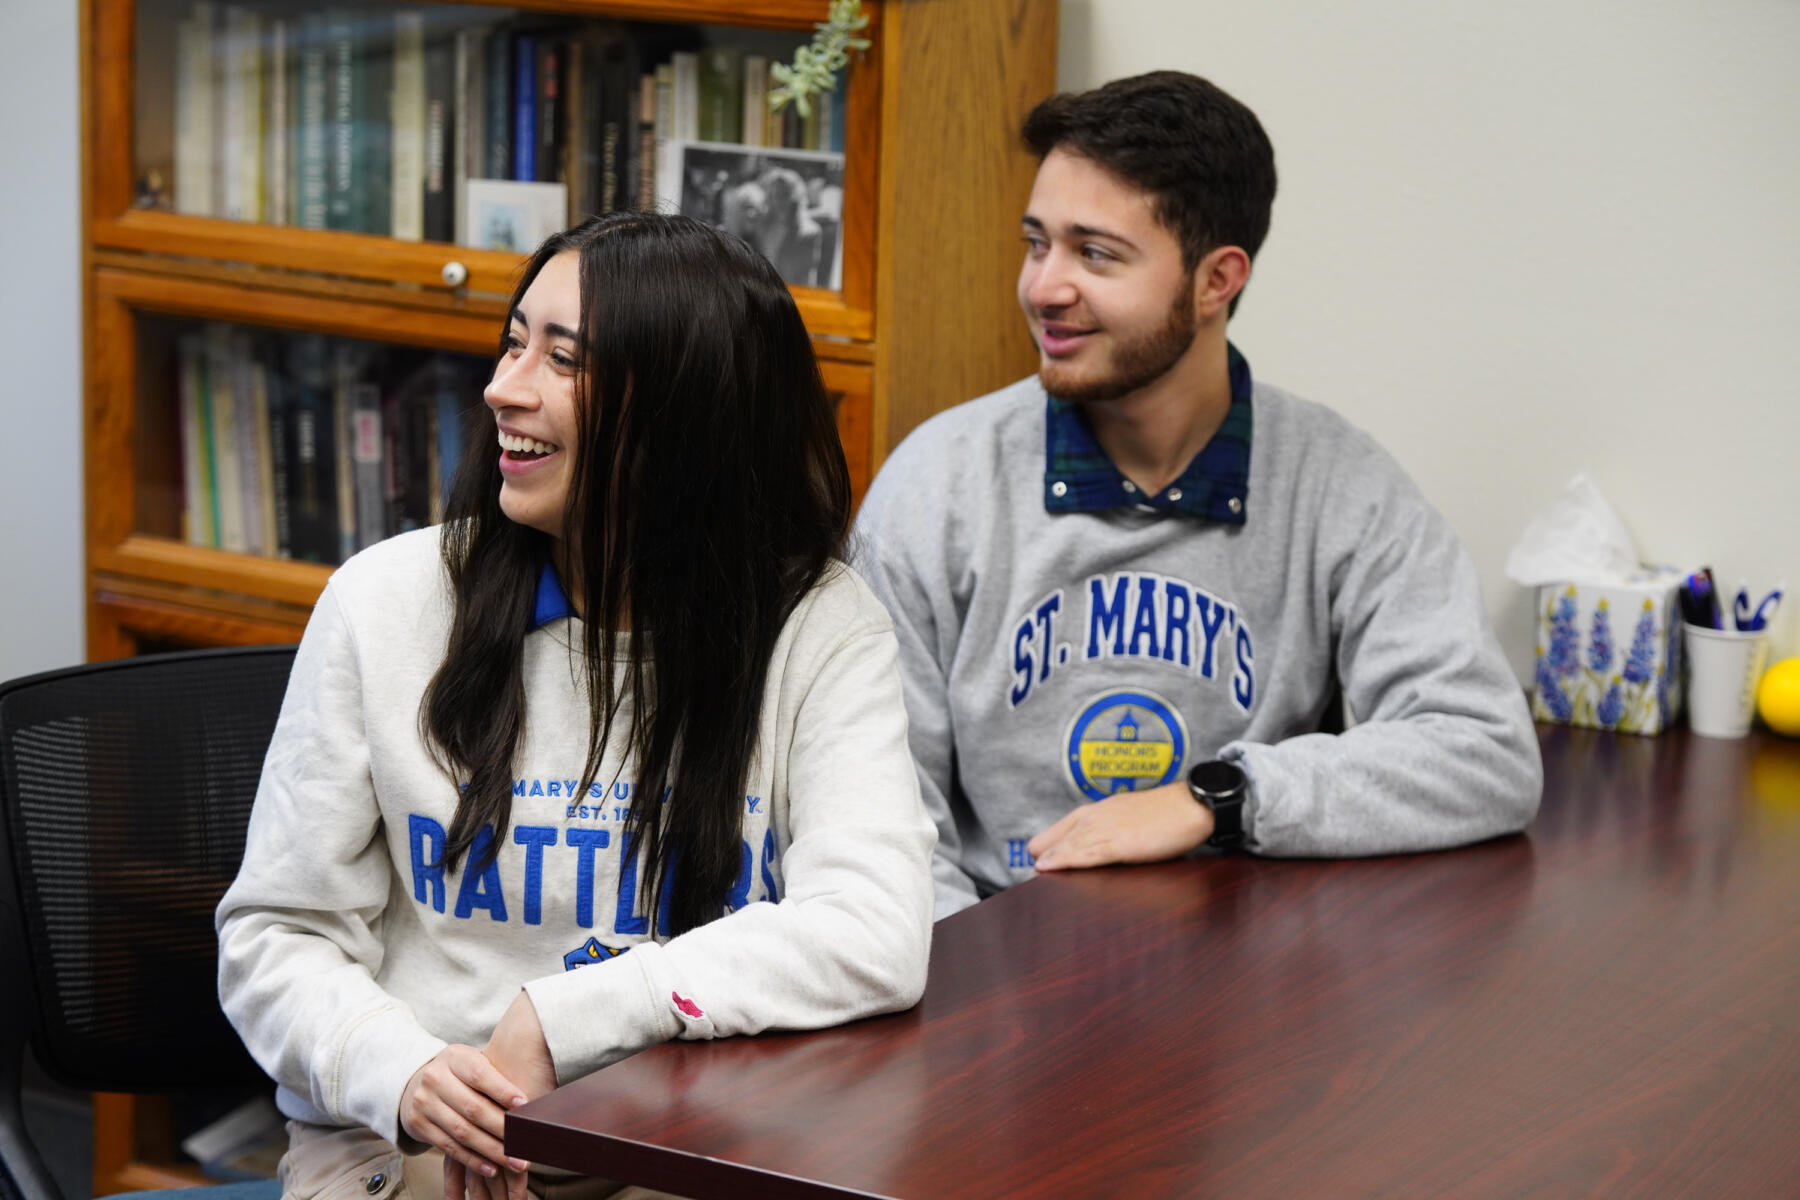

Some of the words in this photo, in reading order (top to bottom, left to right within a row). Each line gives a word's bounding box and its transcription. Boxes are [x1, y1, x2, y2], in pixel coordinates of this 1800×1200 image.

[1009, 592, 1068, 709] ST.
[1086, 574, 1255, 712] MARY'S
[1095, 746, 1158, 757] HONORS
[1090, 761, 1161, 772] PROGRAM
[512, 779, 603, 798] MARYS
[566, 804, 607, 820] EST.
[408, 813, 778, 938] RATTLS
